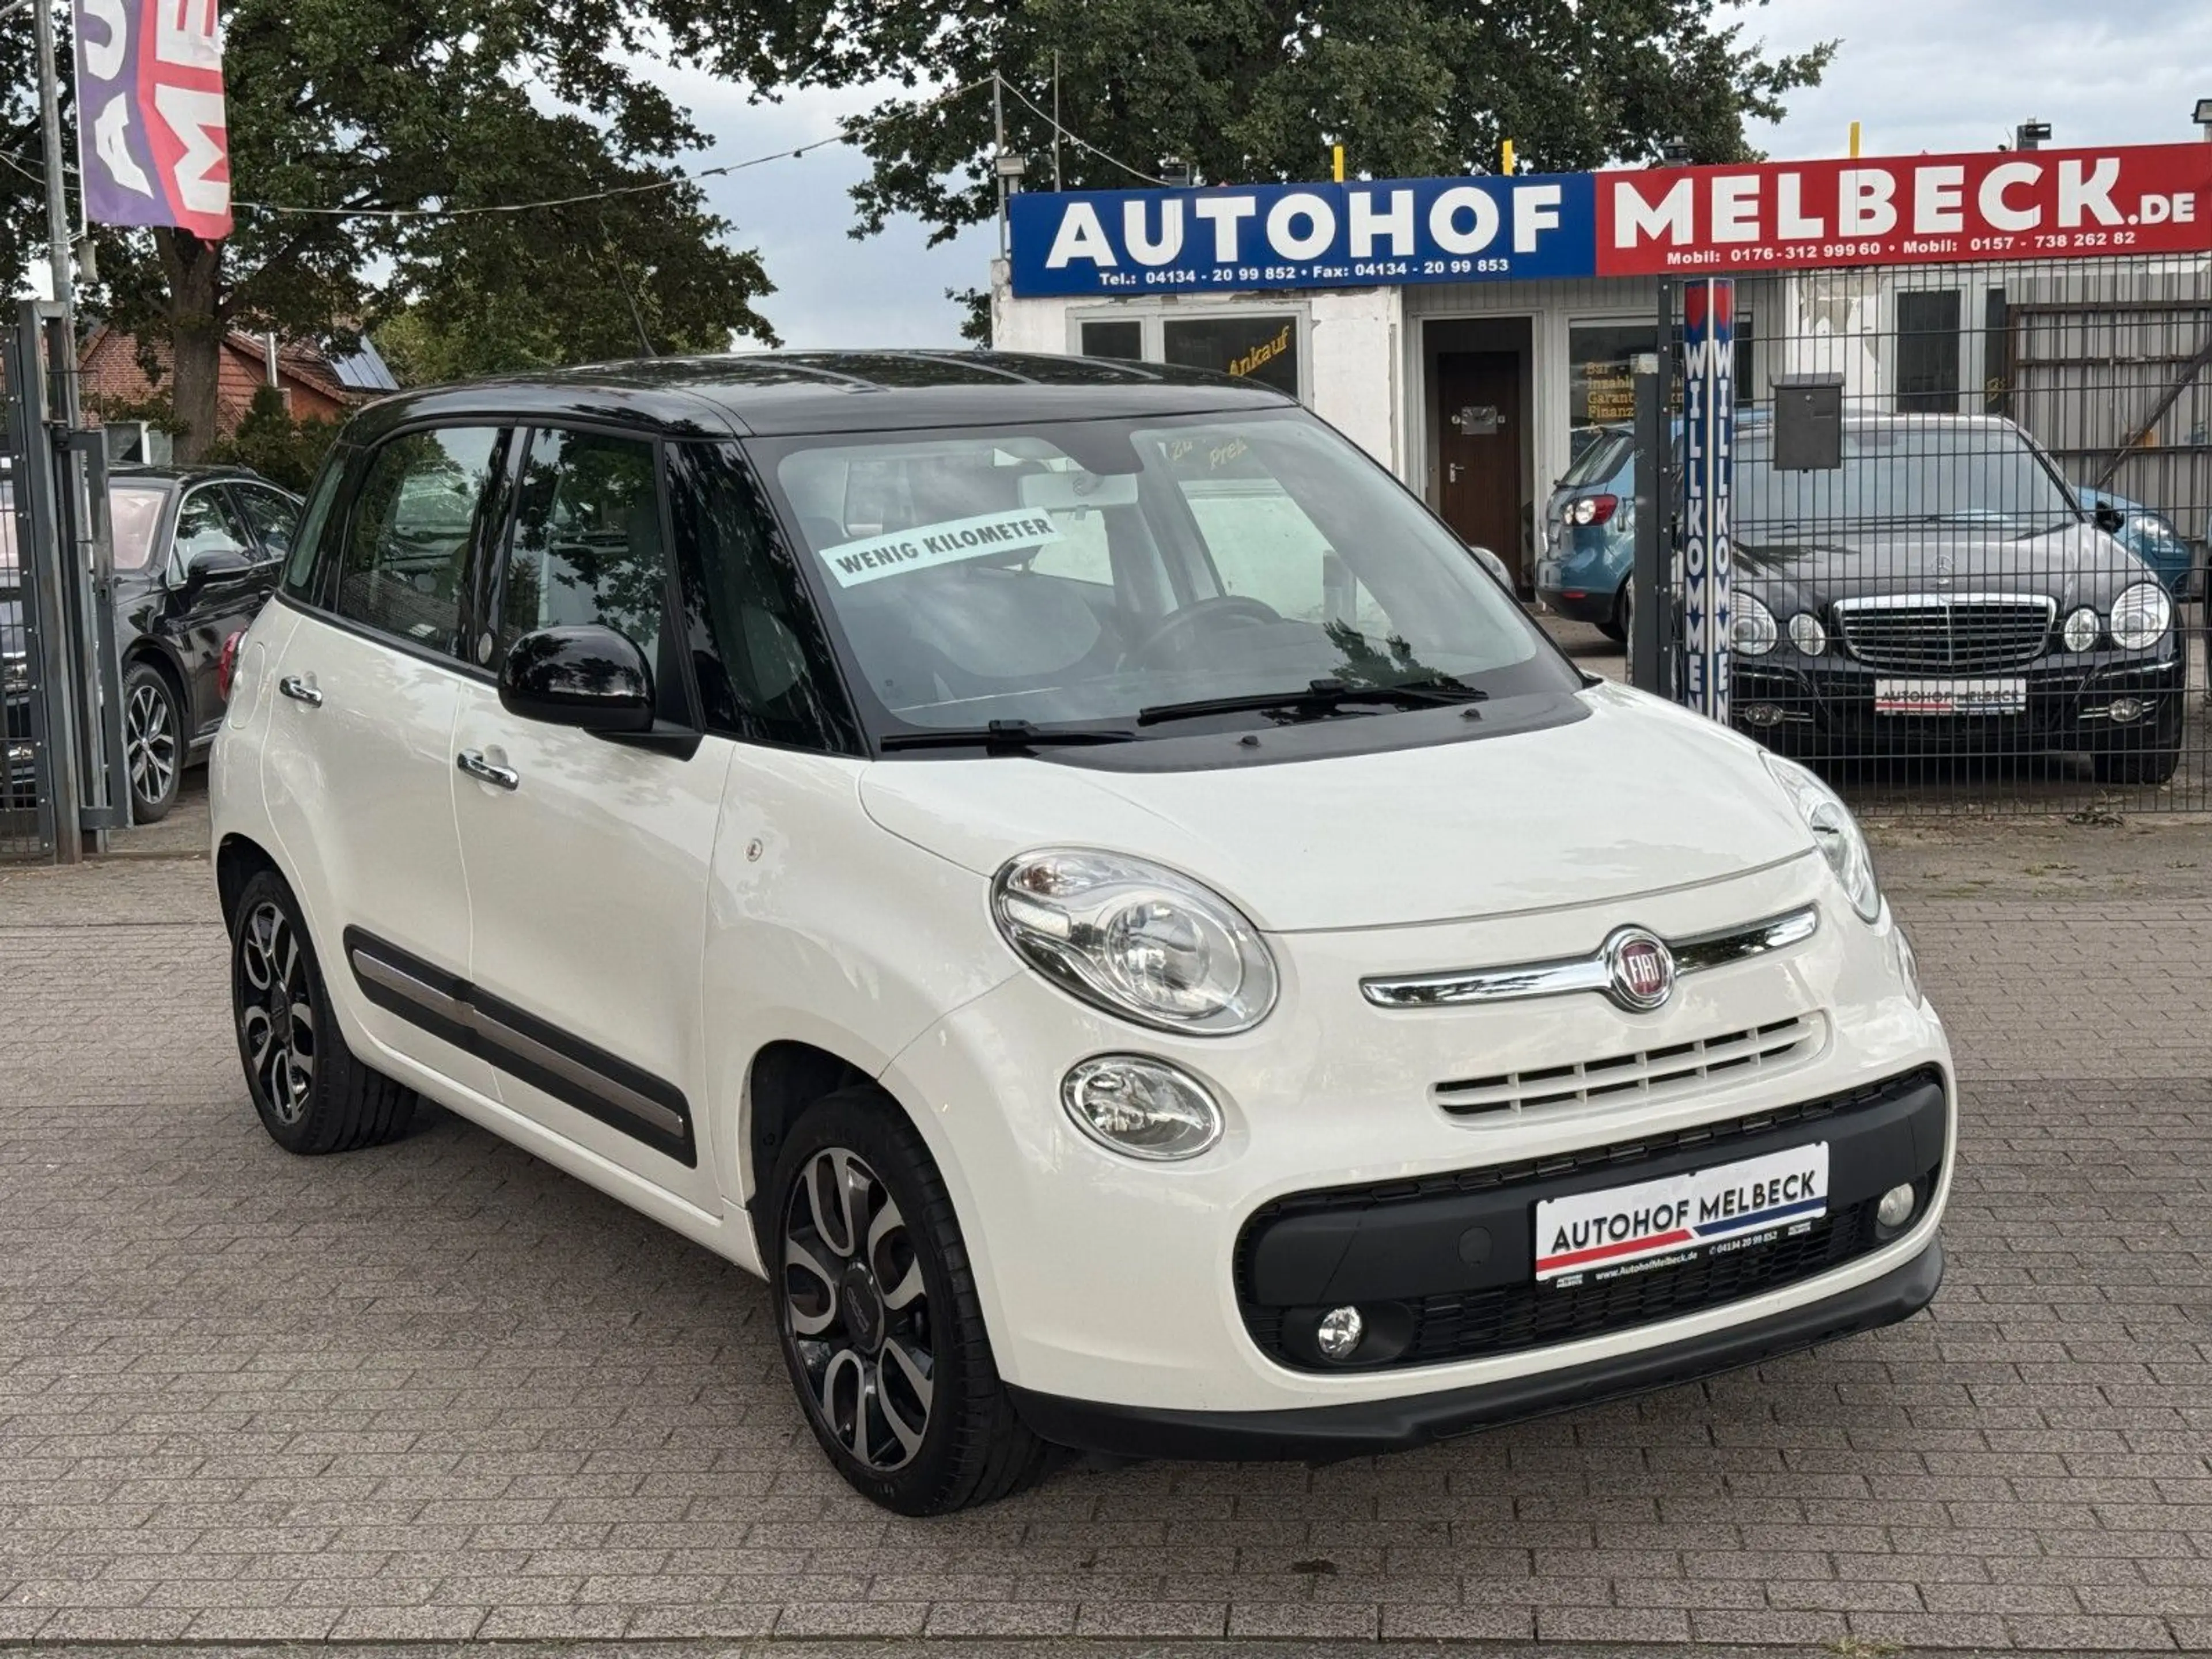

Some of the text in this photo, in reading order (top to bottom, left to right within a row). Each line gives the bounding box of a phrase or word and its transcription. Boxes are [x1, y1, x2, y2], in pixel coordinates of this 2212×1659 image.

[1046, 185, 1561, 268] AUTOHOF
[1667, 250, 1721, 265] Mobil:
[1903, 240, 1957, 253] Mobil:
[1971, 237, 2014, 251] 0157
[2035, 234, 2067, 248] 738
[2074, 233, 2107, 247] 262
[2114, 232, 2135, 244] 82
[1099, 272, 1136, 285] Tel.:
[1146, 270, 1196, 284] 04134
[1213, 269, 1233, 281] 20
[1238, 268, 1259, 280] 99
[1265, 267, 1296, 279] 852
[1313, 266, 1349, 278] Fax:
[1355, 262, 1407, 276] 04134
[1425, 261, 1444, 274] 20
[1450, 260, 1472, 273] 99
[1478, 259, 1509, 272] 853
[1230, 325, 1289, 377] Ankauf
[836, 518, 1055, 574] WENIG KILOMETER
[1627, 953, 1660, 984] FIAT
[1551, 1170, 1816, 1255] AUTOHOF MELBECK
